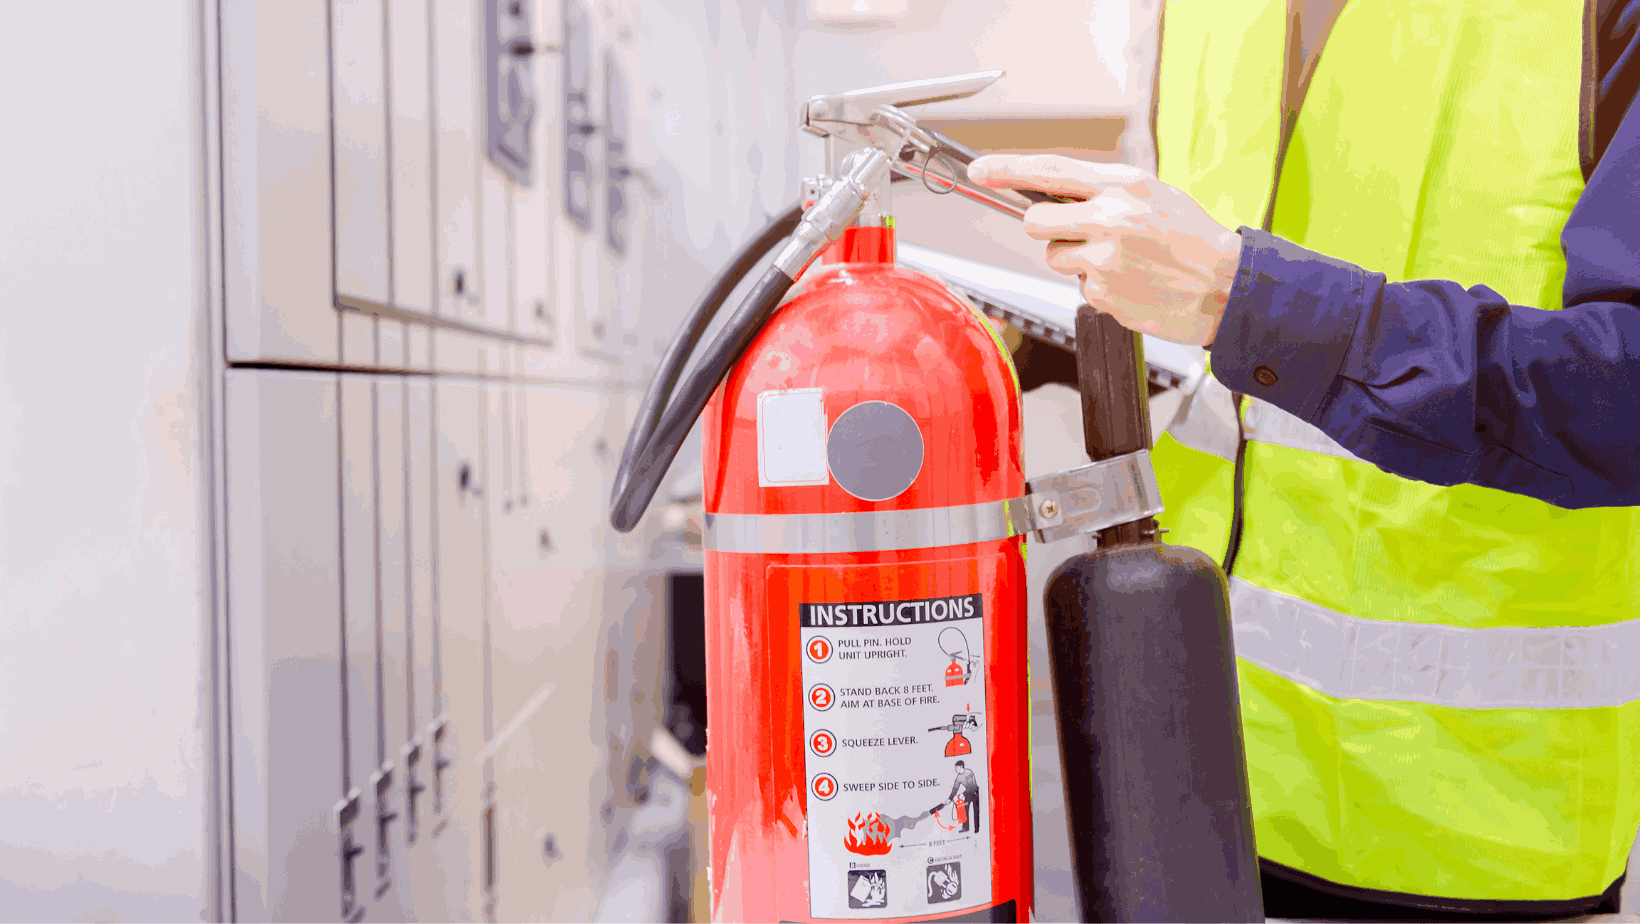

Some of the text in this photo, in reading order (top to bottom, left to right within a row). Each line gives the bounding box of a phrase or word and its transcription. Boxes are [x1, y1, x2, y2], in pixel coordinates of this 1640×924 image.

[810, 596, 975, 626] INSTRUCTIONS
[813, 637, 912, 657] 1 PULL PIN. HOLD
[838, 649, 908, 660] UNIT UPRIGHT.
[815, 684, 934, 705] 2 STAND BACK 8 FEET.
[840, 695, 940, 709] AIM AT BASE OF FIRE.
[817, 736, 919, 751] 3 SQUEEZE LEVER.
[818, 778, 940, 794] 4 SWEEP SIDE TO SIDE.
